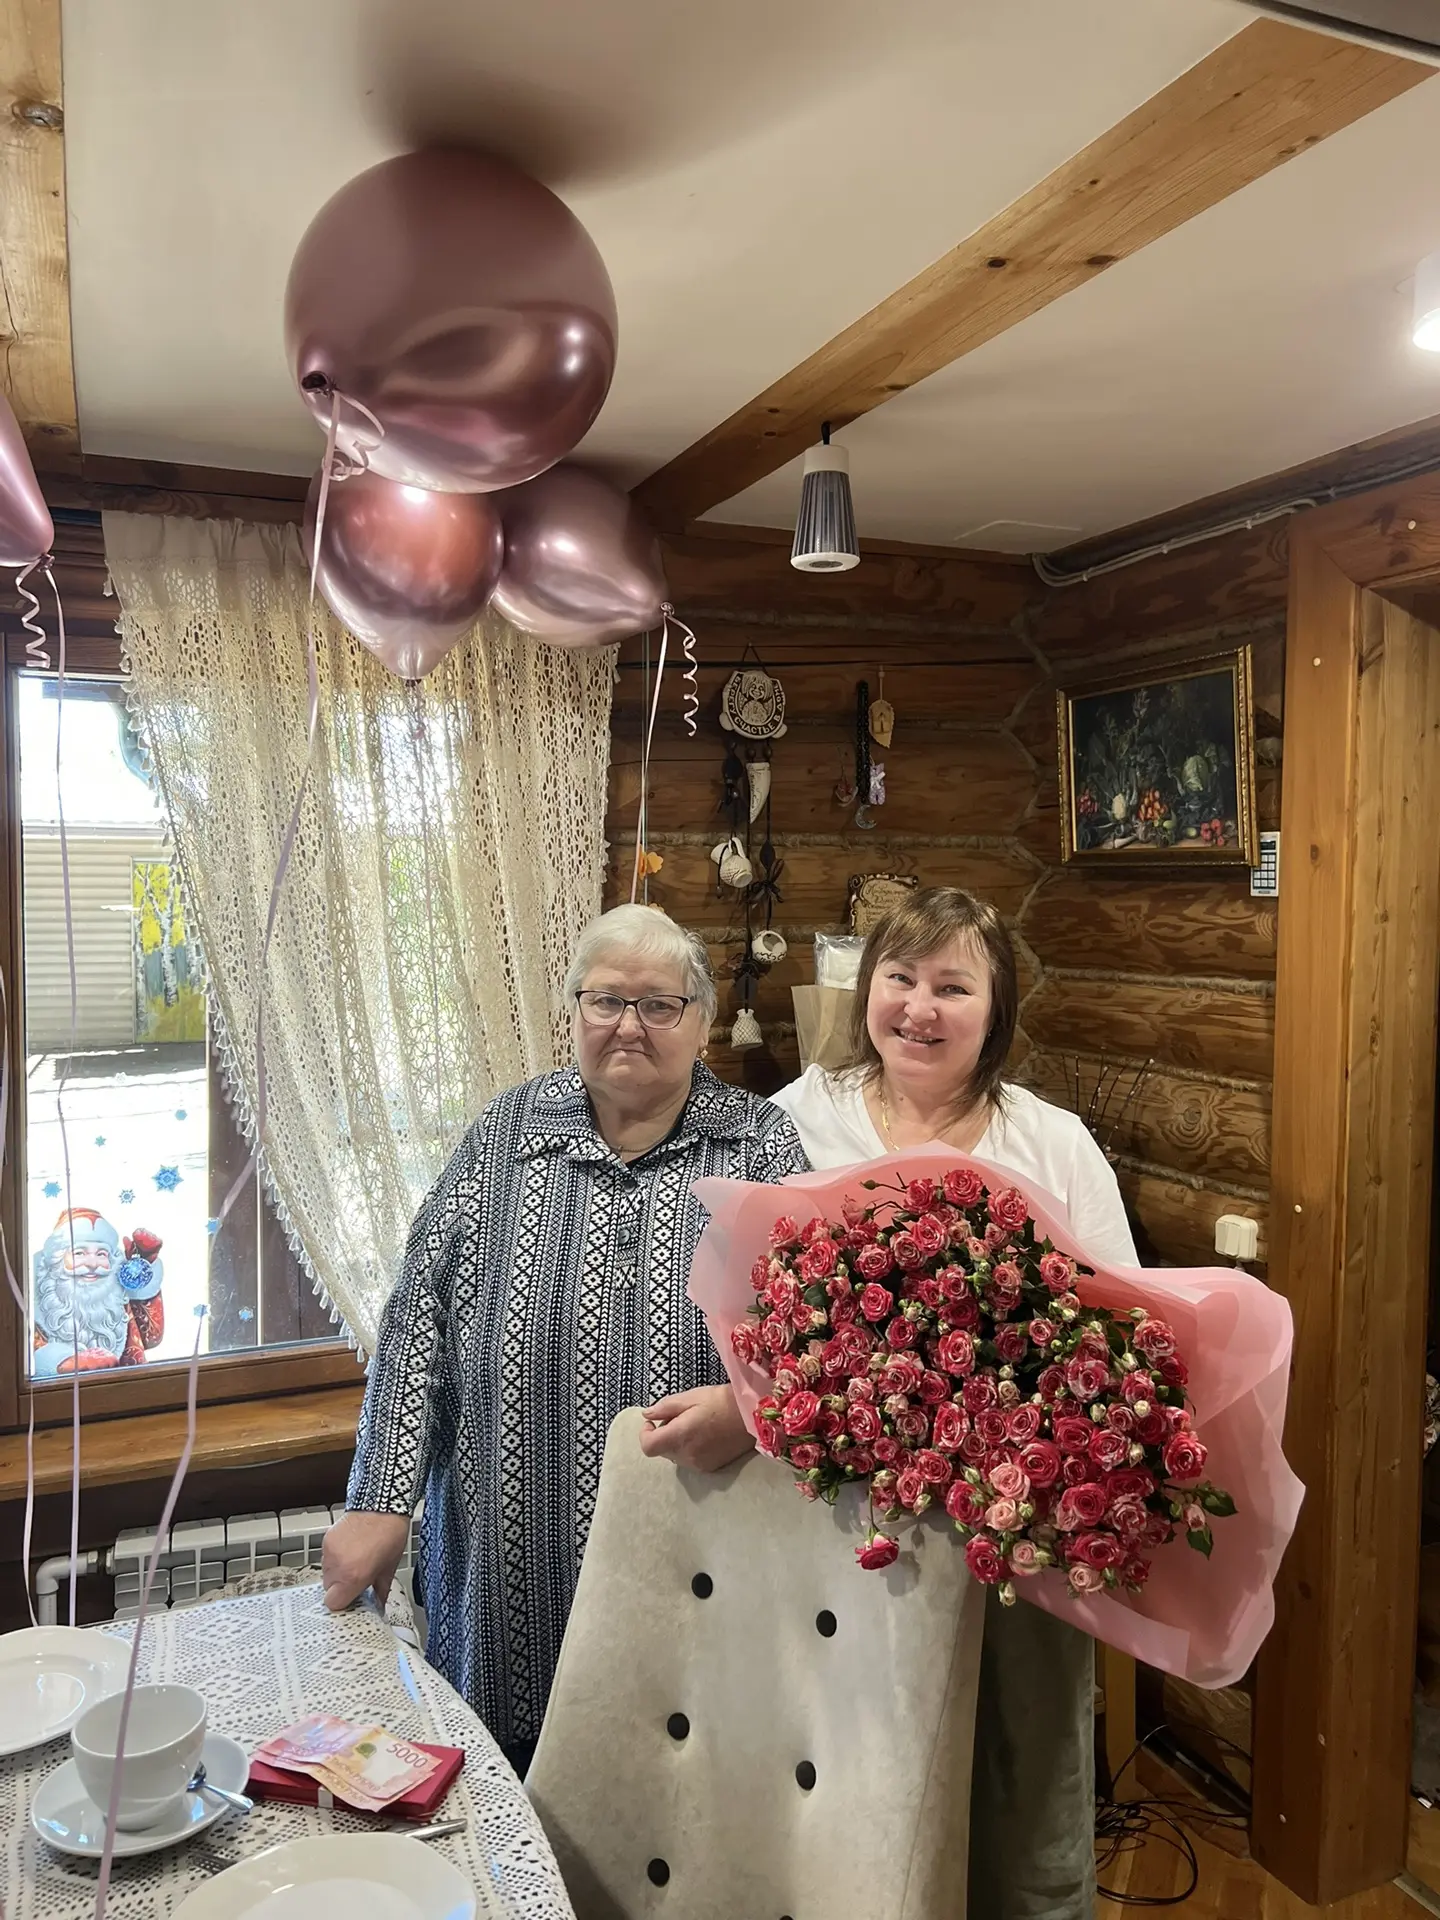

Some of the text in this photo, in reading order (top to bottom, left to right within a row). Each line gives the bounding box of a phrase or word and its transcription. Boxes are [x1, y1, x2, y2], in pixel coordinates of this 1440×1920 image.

[728, 675, 742, 714] БЕРЕГУ
[734, 716, 776, 735] СЧАСТЬЕ
[773, 714, 781, 722] В
[386, 1743, 428, 1769] 5000
